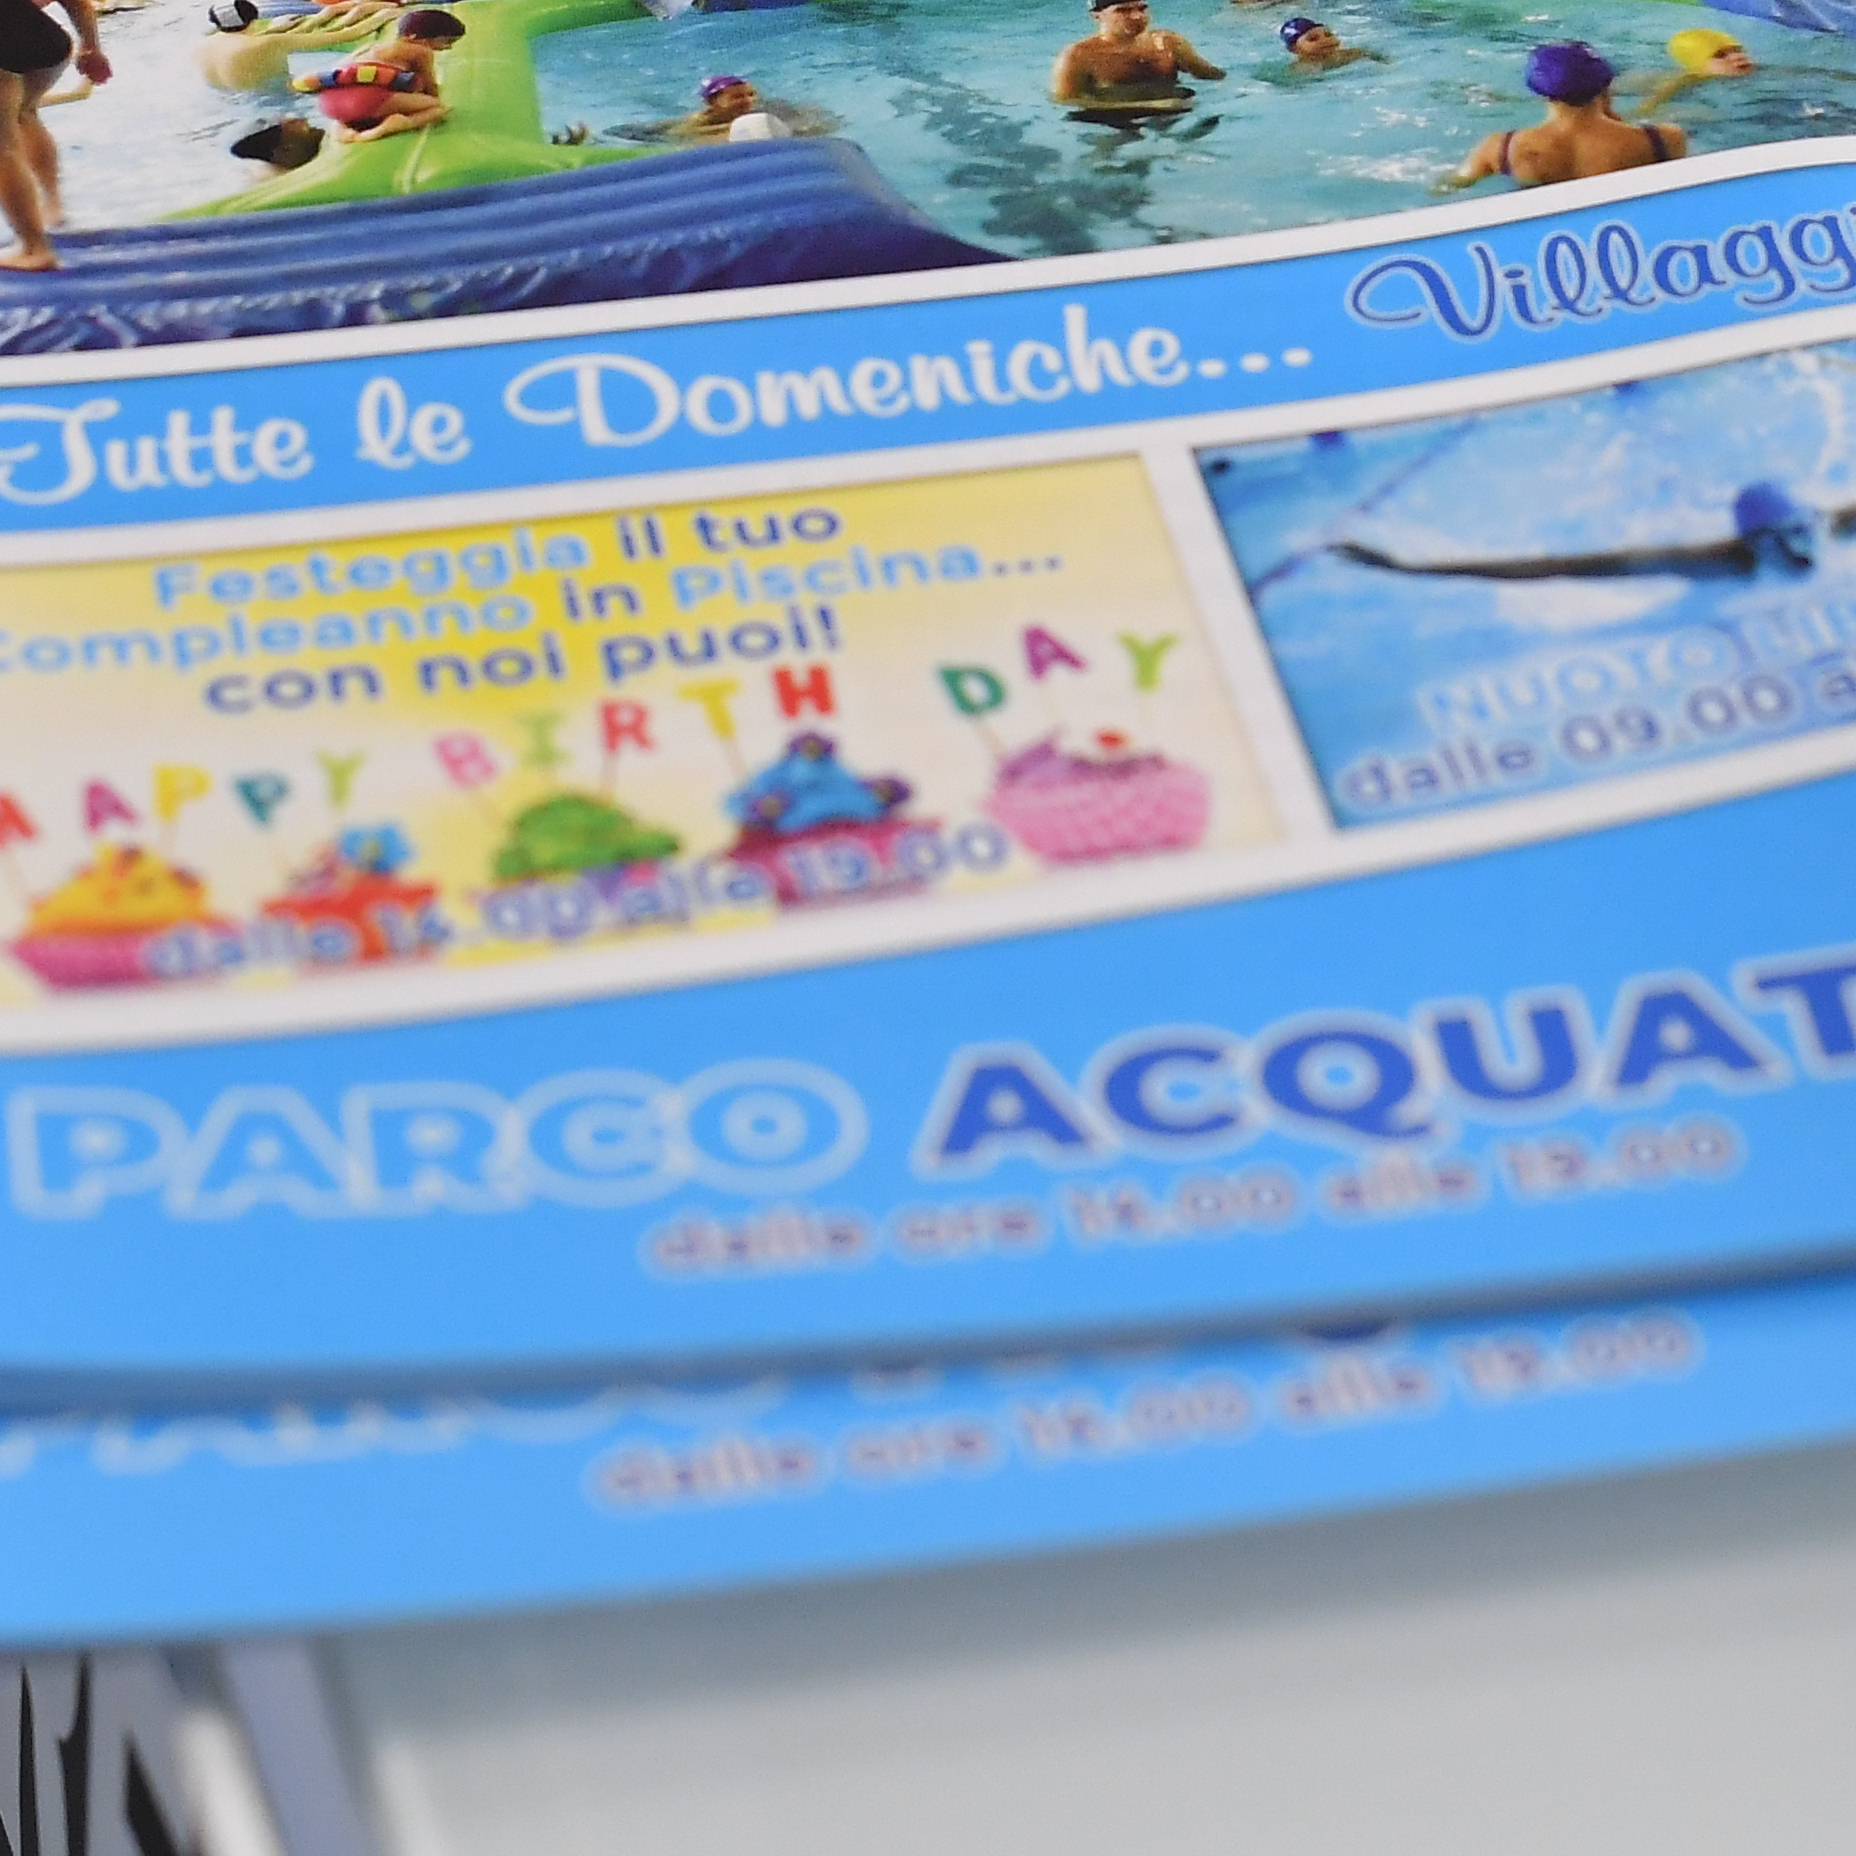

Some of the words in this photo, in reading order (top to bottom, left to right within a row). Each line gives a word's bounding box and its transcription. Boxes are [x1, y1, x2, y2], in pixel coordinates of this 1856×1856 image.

[356, 375, 473, 472] le
[501, 302, 1313, 448] Domeniche...
[153, 524, 590, 611] Festeggia
[614, 512, 666, 561] il
[693, 507, 840, 552] tuo
[560, 576, 640, 622] in
[204, 663, 386, 715] con
[416, 630, 569, 697] noi
[600, 603, 841, 685] puoi!
[432, 662, 836, 792] BIRTH
[936, 624, 1180, 719] DAY
[1416, 626, 1740, 728] NUOTO
[1346, 735, 1536, 805] dalle
[1560, 674, 1793, 764] 09.00
[5, 1056, 871, 1222] PARCO
